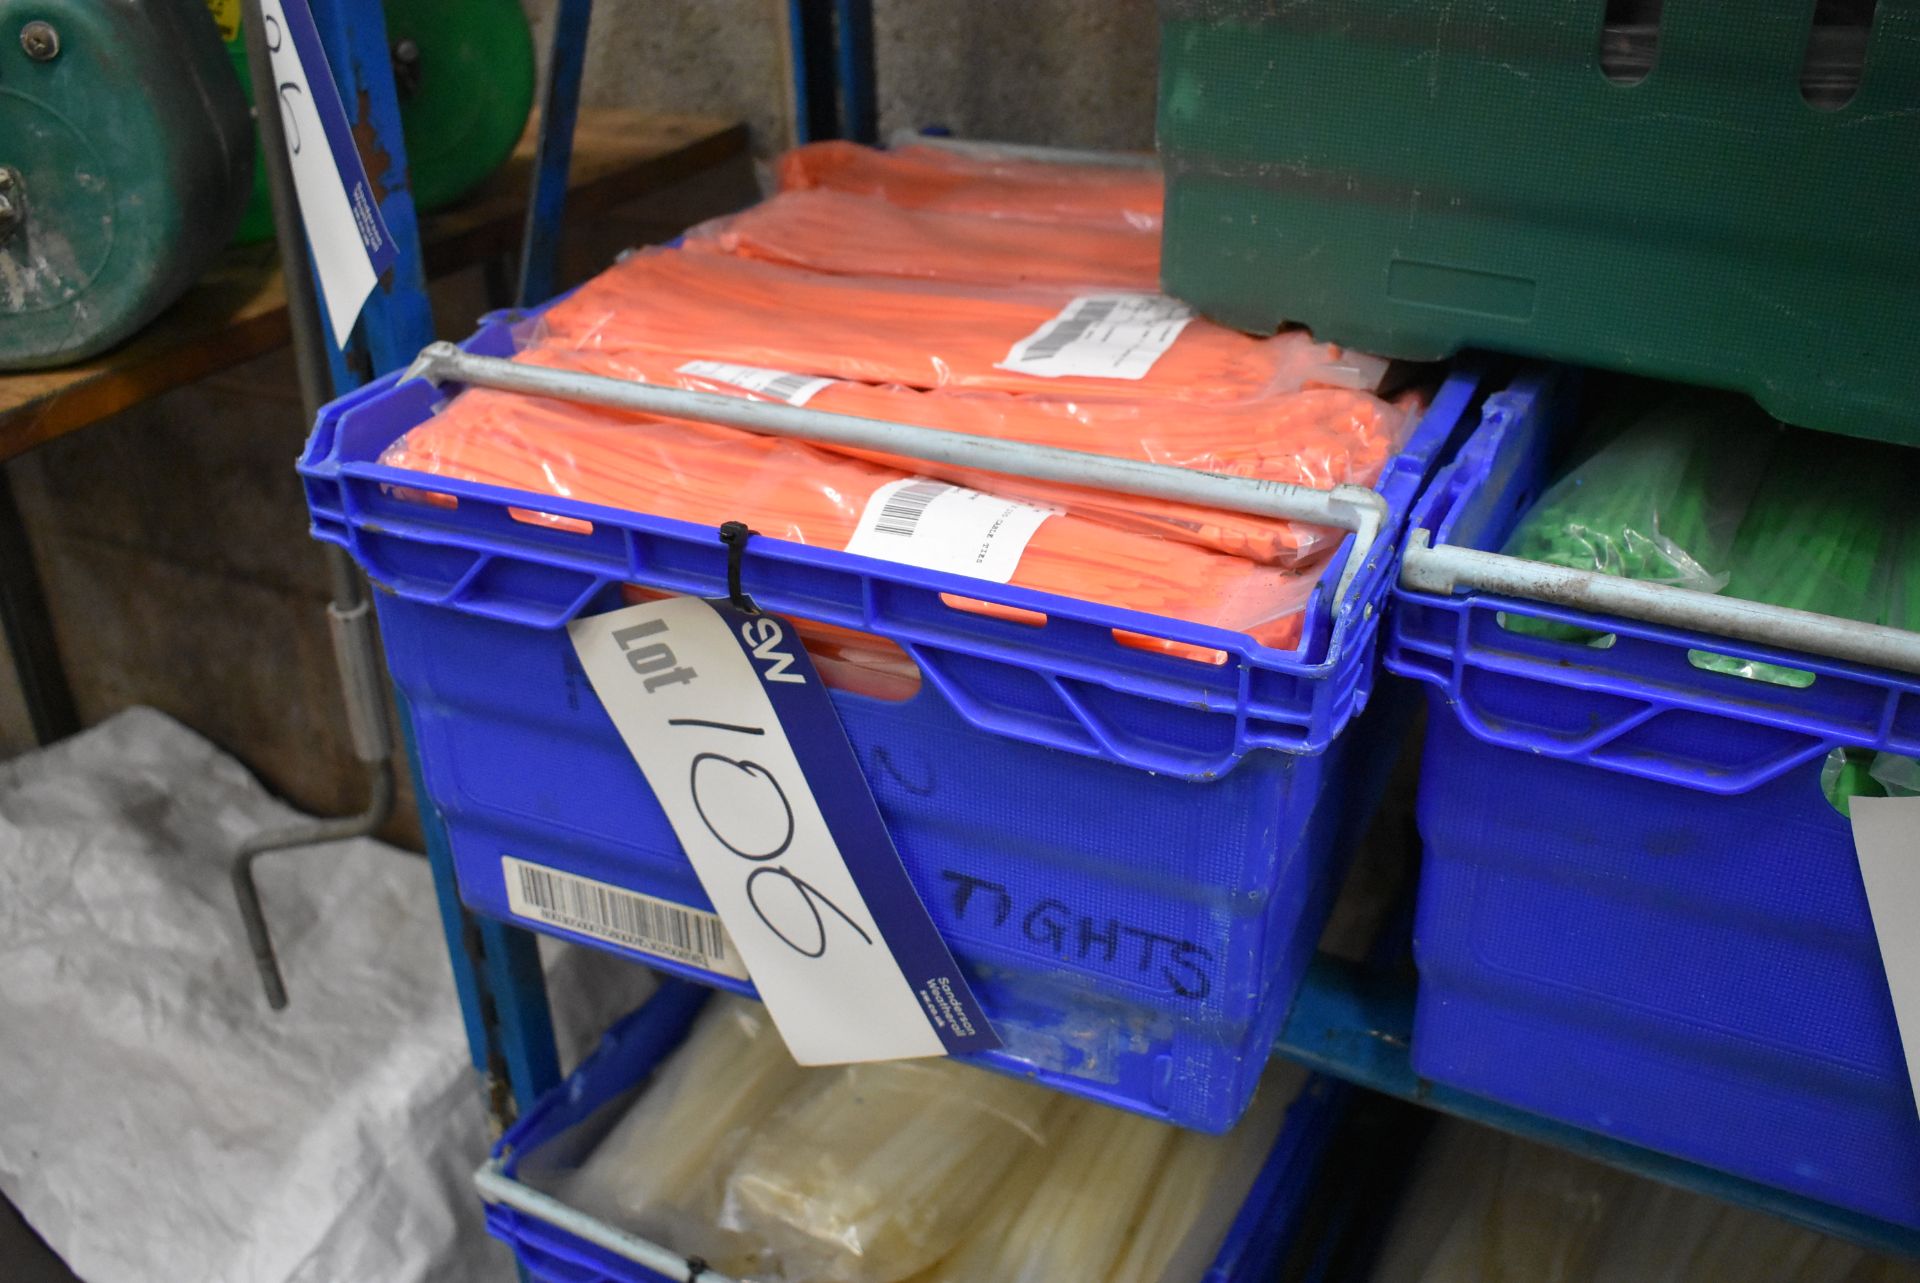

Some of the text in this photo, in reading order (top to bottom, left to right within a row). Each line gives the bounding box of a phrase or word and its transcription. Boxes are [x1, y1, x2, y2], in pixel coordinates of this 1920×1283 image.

[741, 617, 807, 685] SW
[611, 618, 874, 959] Lot 106
[941, 868, 1214, 1000] TIGHTS
[927, 978, 967, 1037] Weatherall
[938, 977, 976, 1036] Sanderson
